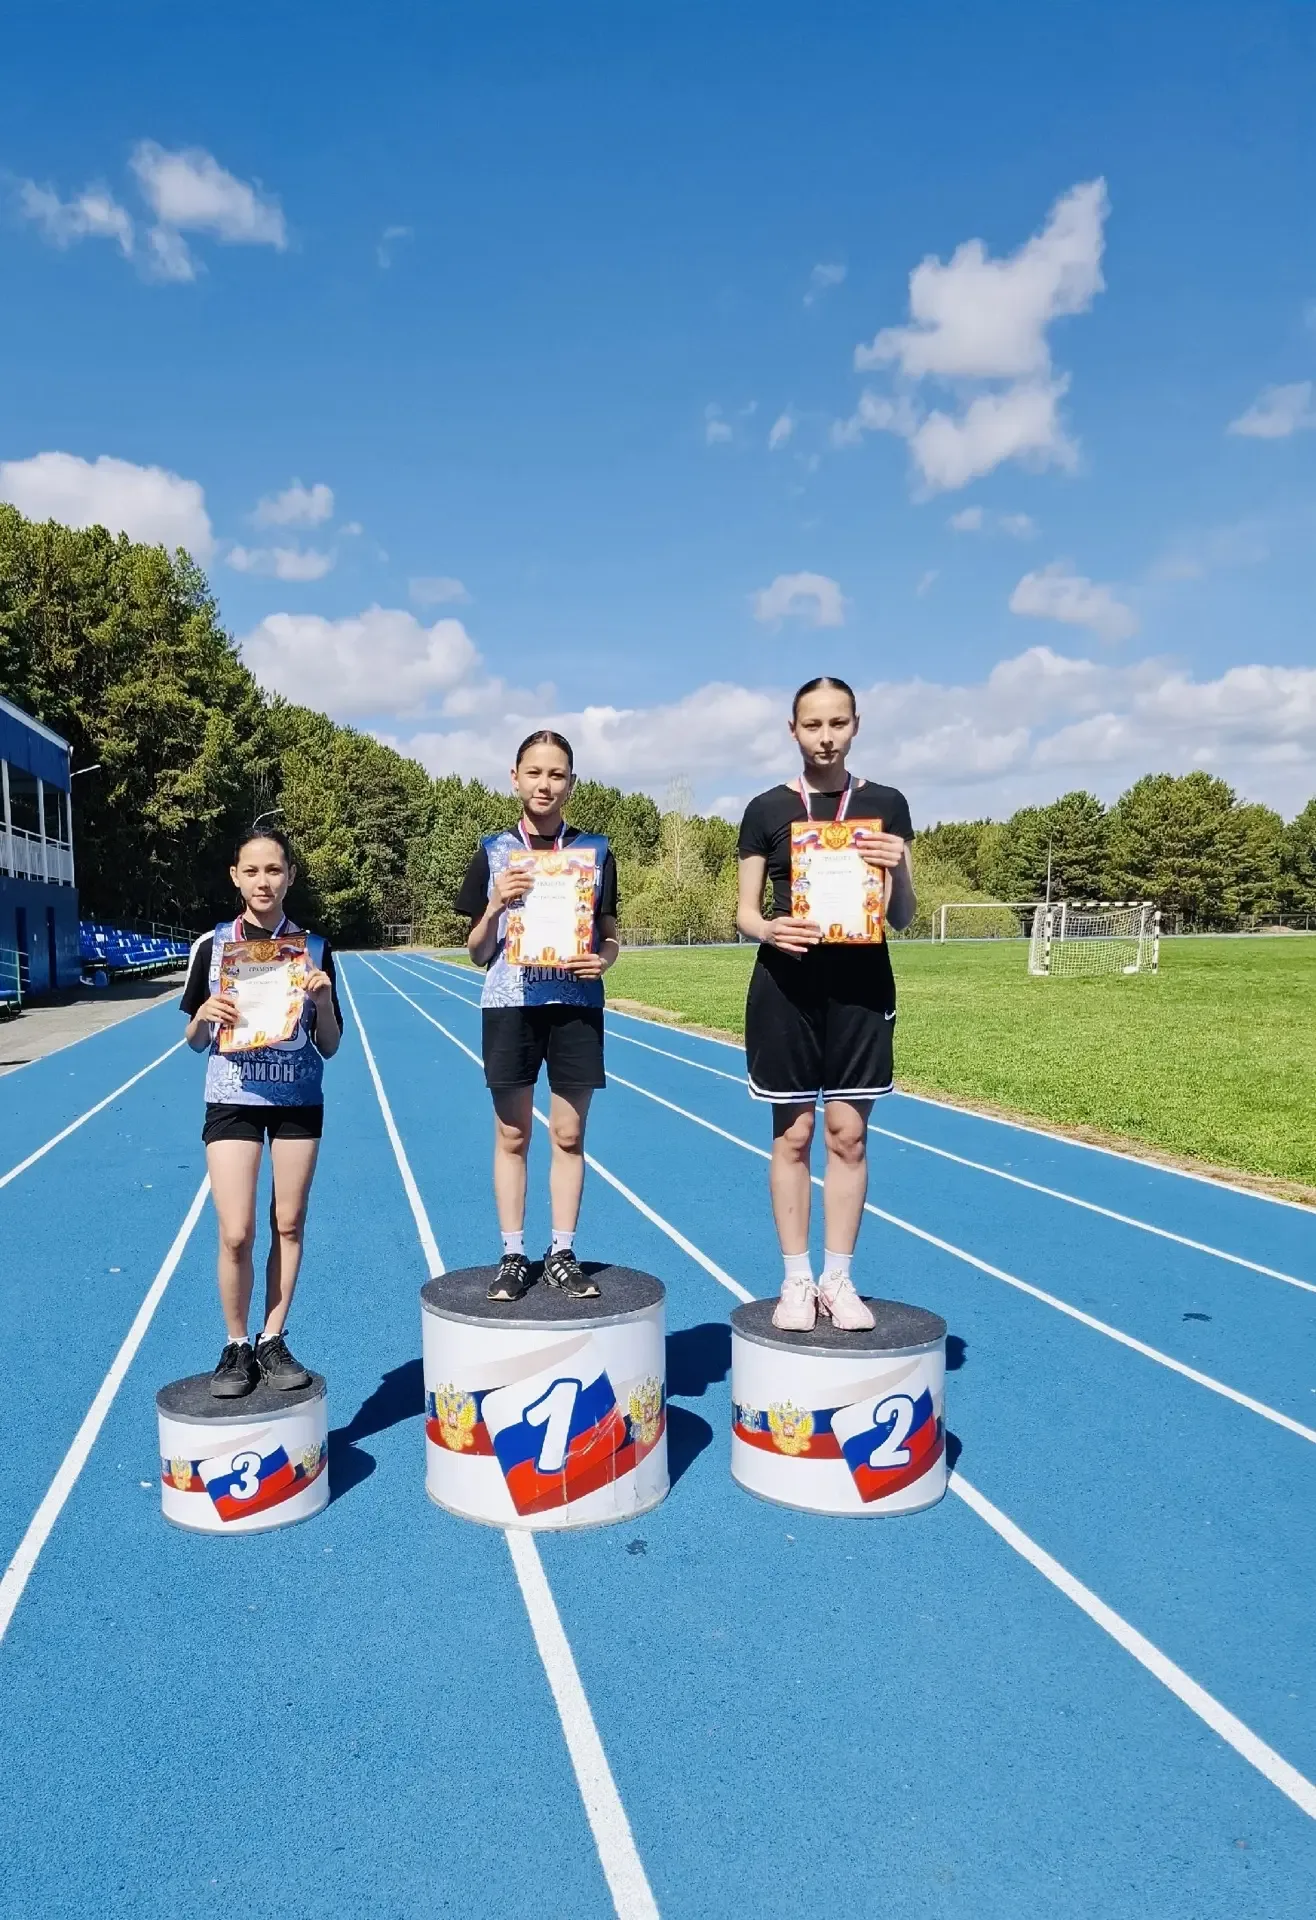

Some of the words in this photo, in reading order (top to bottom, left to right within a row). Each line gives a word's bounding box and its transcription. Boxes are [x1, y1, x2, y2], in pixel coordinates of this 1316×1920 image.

[227, 1053, 296, 1083] РАЙОН
[522, 1377, 582, 1474] 1
[869, 1394, 916, 1470] 2
[229, 1451, 262, 1501] 3
